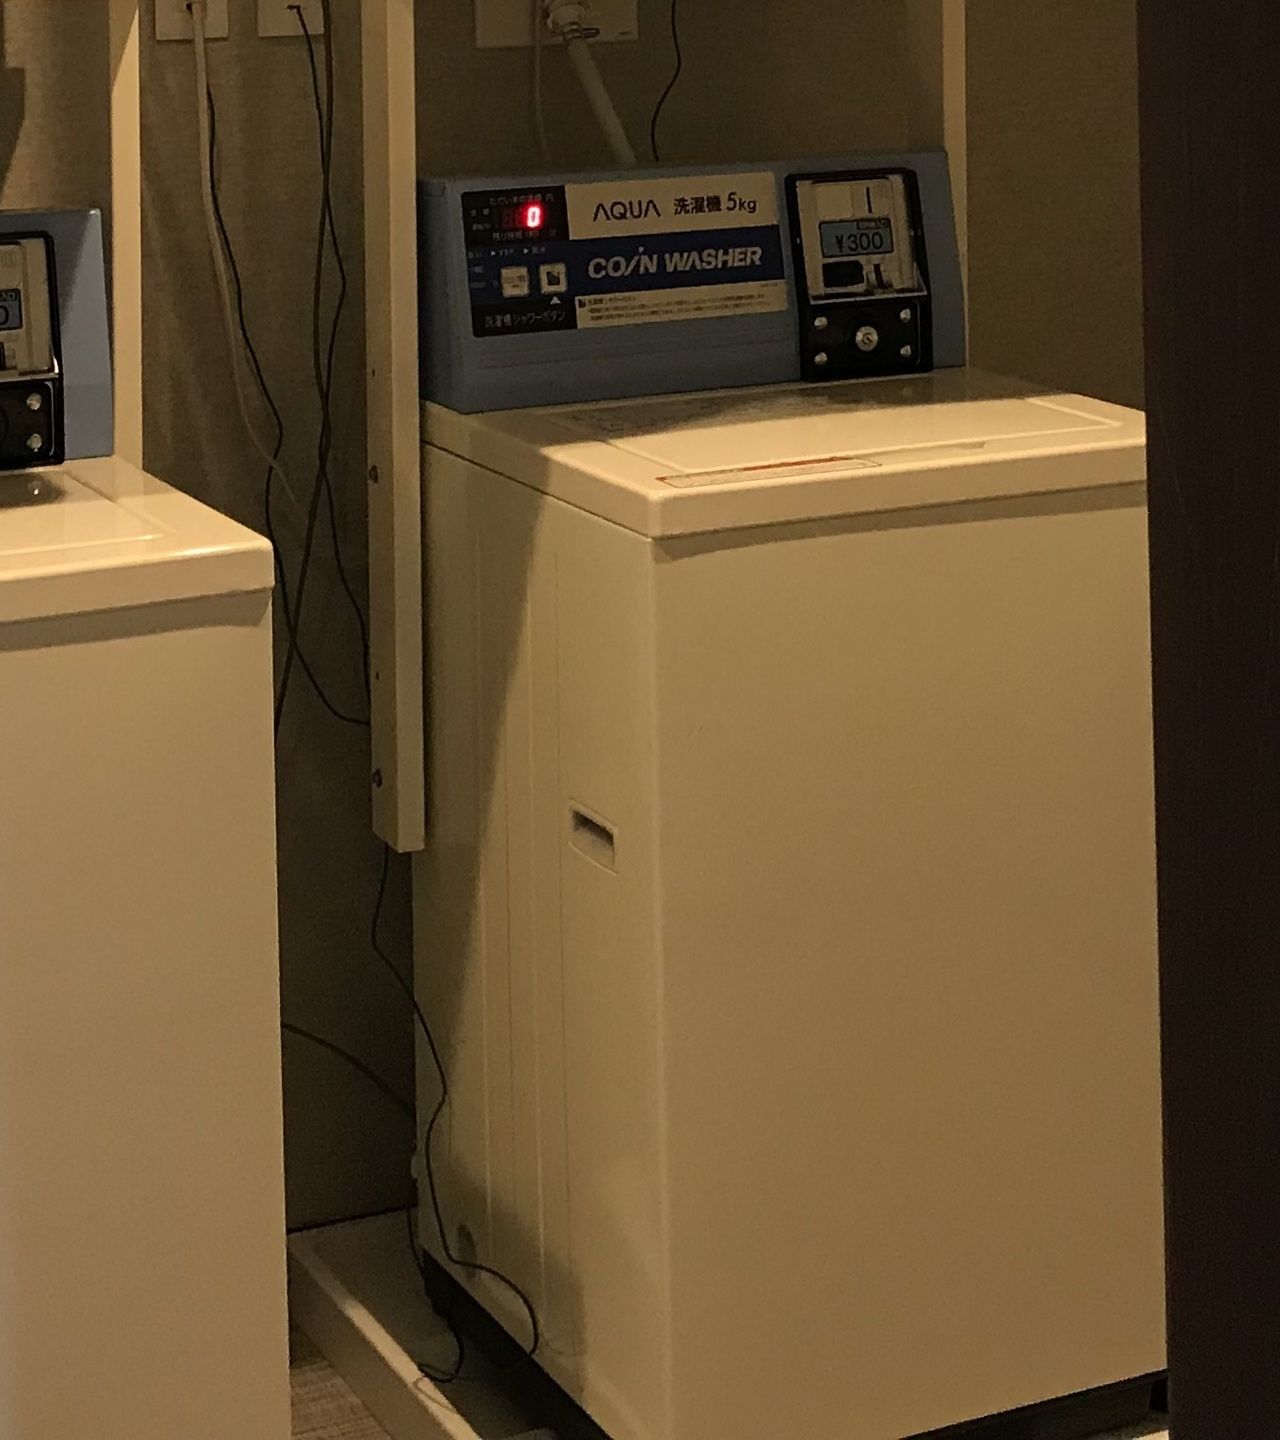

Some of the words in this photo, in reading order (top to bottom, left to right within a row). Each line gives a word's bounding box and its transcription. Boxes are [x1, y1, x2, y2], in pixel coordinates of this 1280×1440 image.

[526, 206, 541, 228] 0
[592, 198, 662, 222] AQUA
[673, 195, 722, 216] 洗濯機
[725, 191, 758, 213] 5kg
[834, 230, 883, 253] ¥300
[665, 246, 762, 273] WASHER
